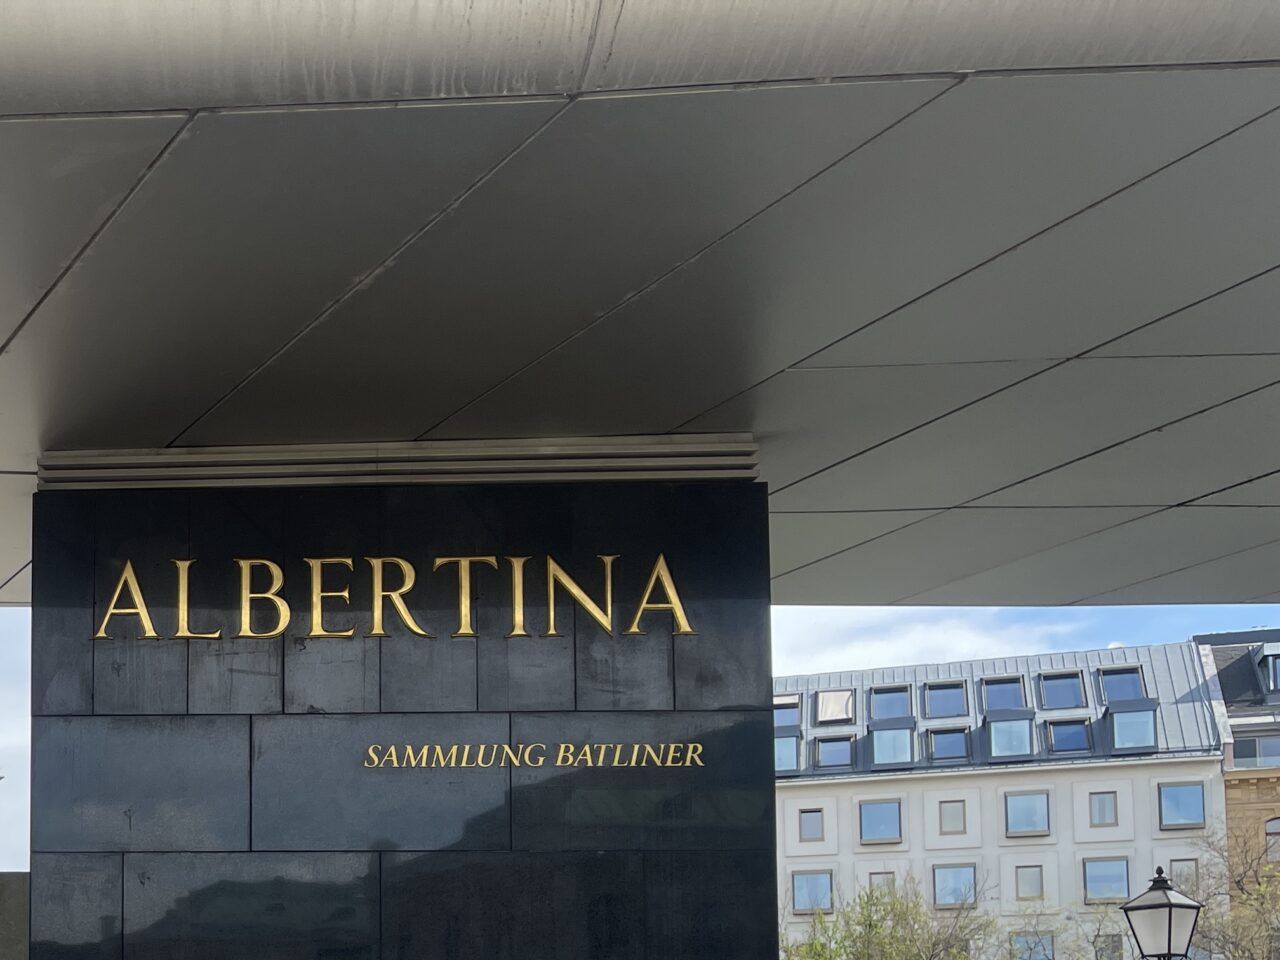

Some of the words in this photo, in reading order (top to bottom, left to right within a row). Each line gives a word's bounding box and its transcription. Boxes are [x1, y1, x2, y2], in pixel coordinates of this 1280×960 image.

[90, 553, 699, 640] ALBERTINA
[364, 744, 547, 768] SAMMLUNG
[555, 743, 705, 768] BATLINER
